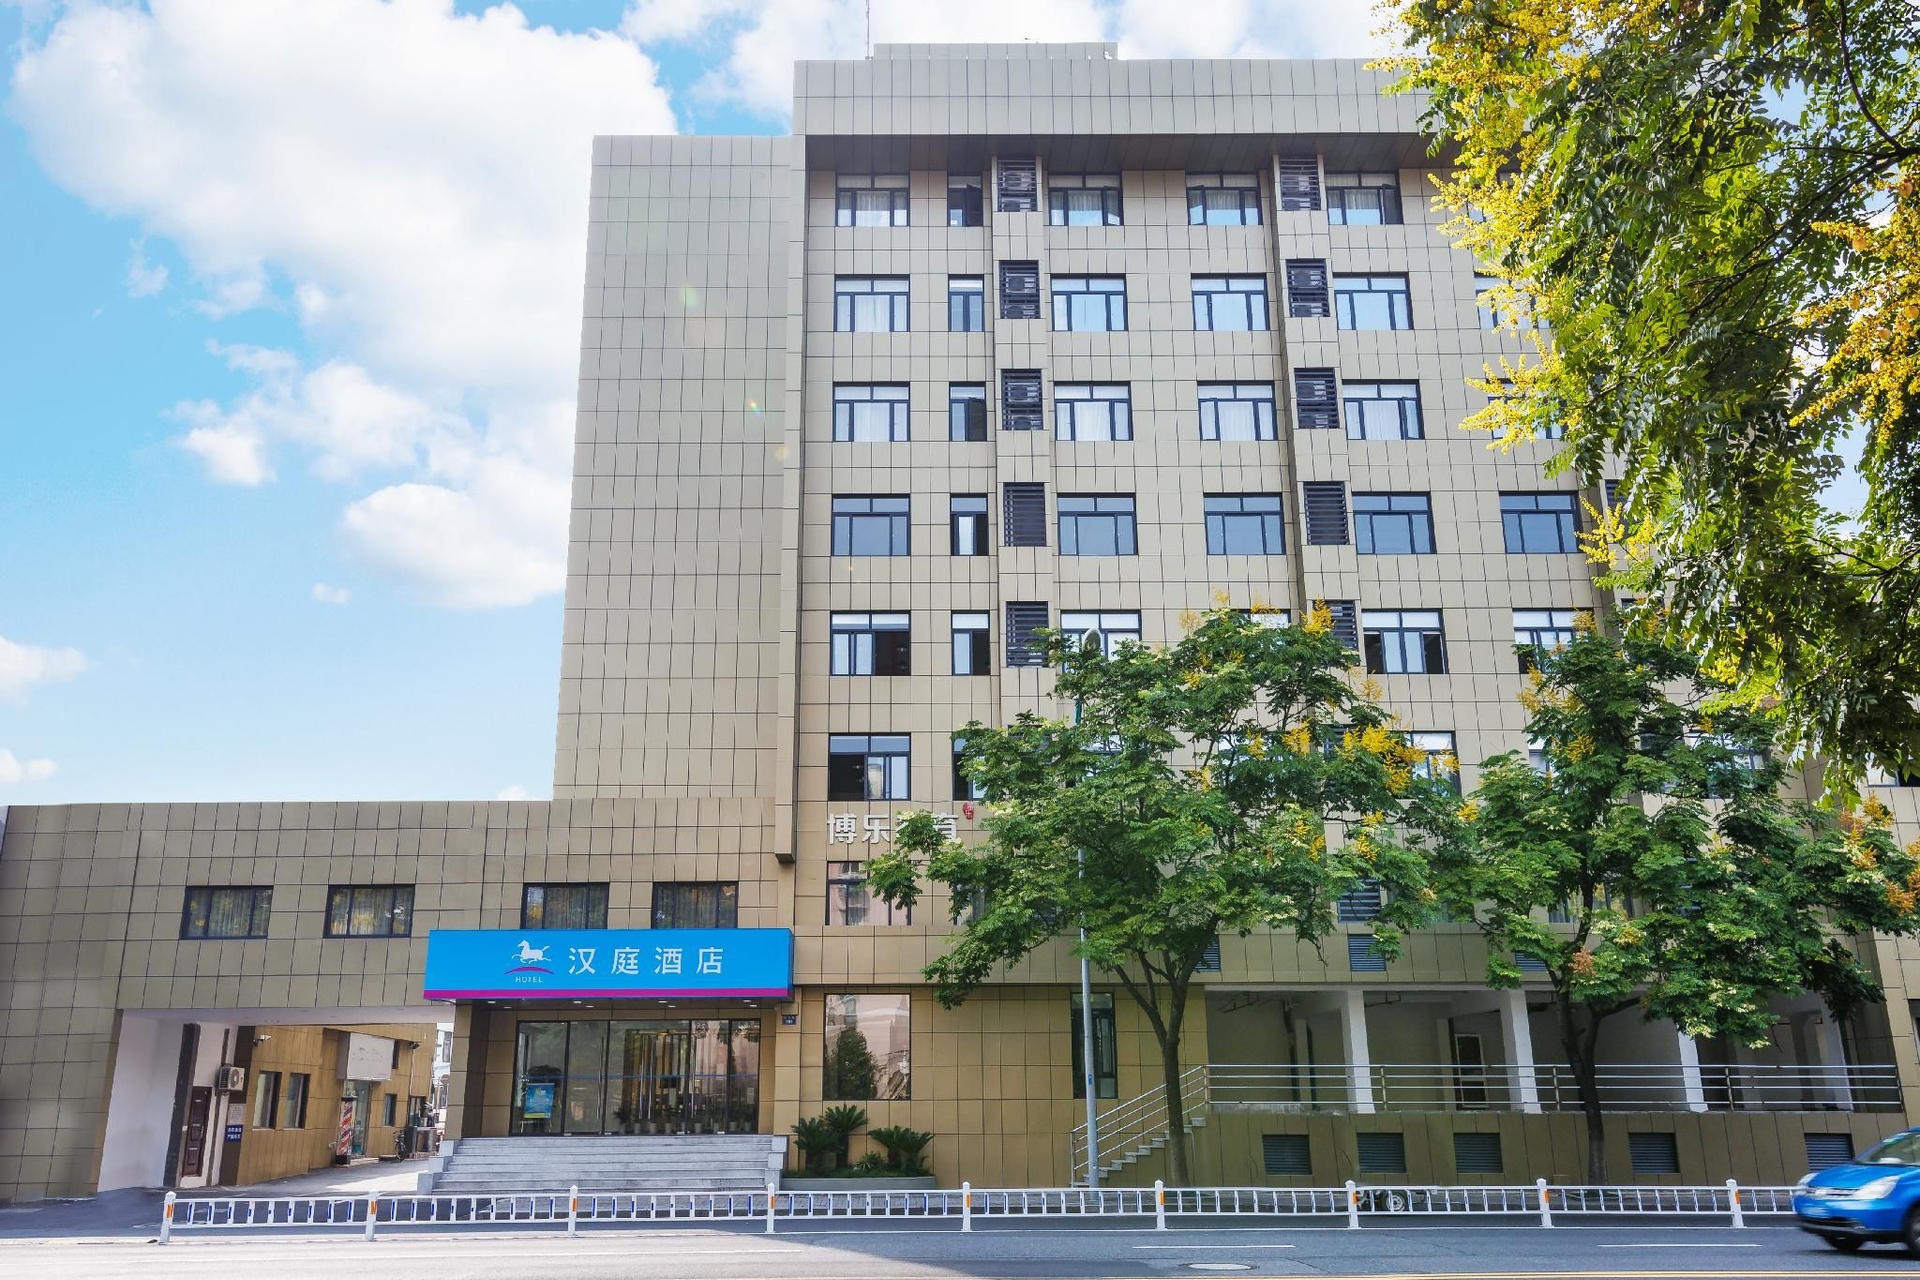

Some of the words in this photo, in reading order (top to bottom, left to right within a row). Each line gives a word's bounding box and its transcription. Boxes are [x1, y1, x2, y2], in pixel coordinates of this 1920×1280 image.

[827, 812, 959, 845] 博乐育
[568, 946, 724, 975] 汉庭酒店
